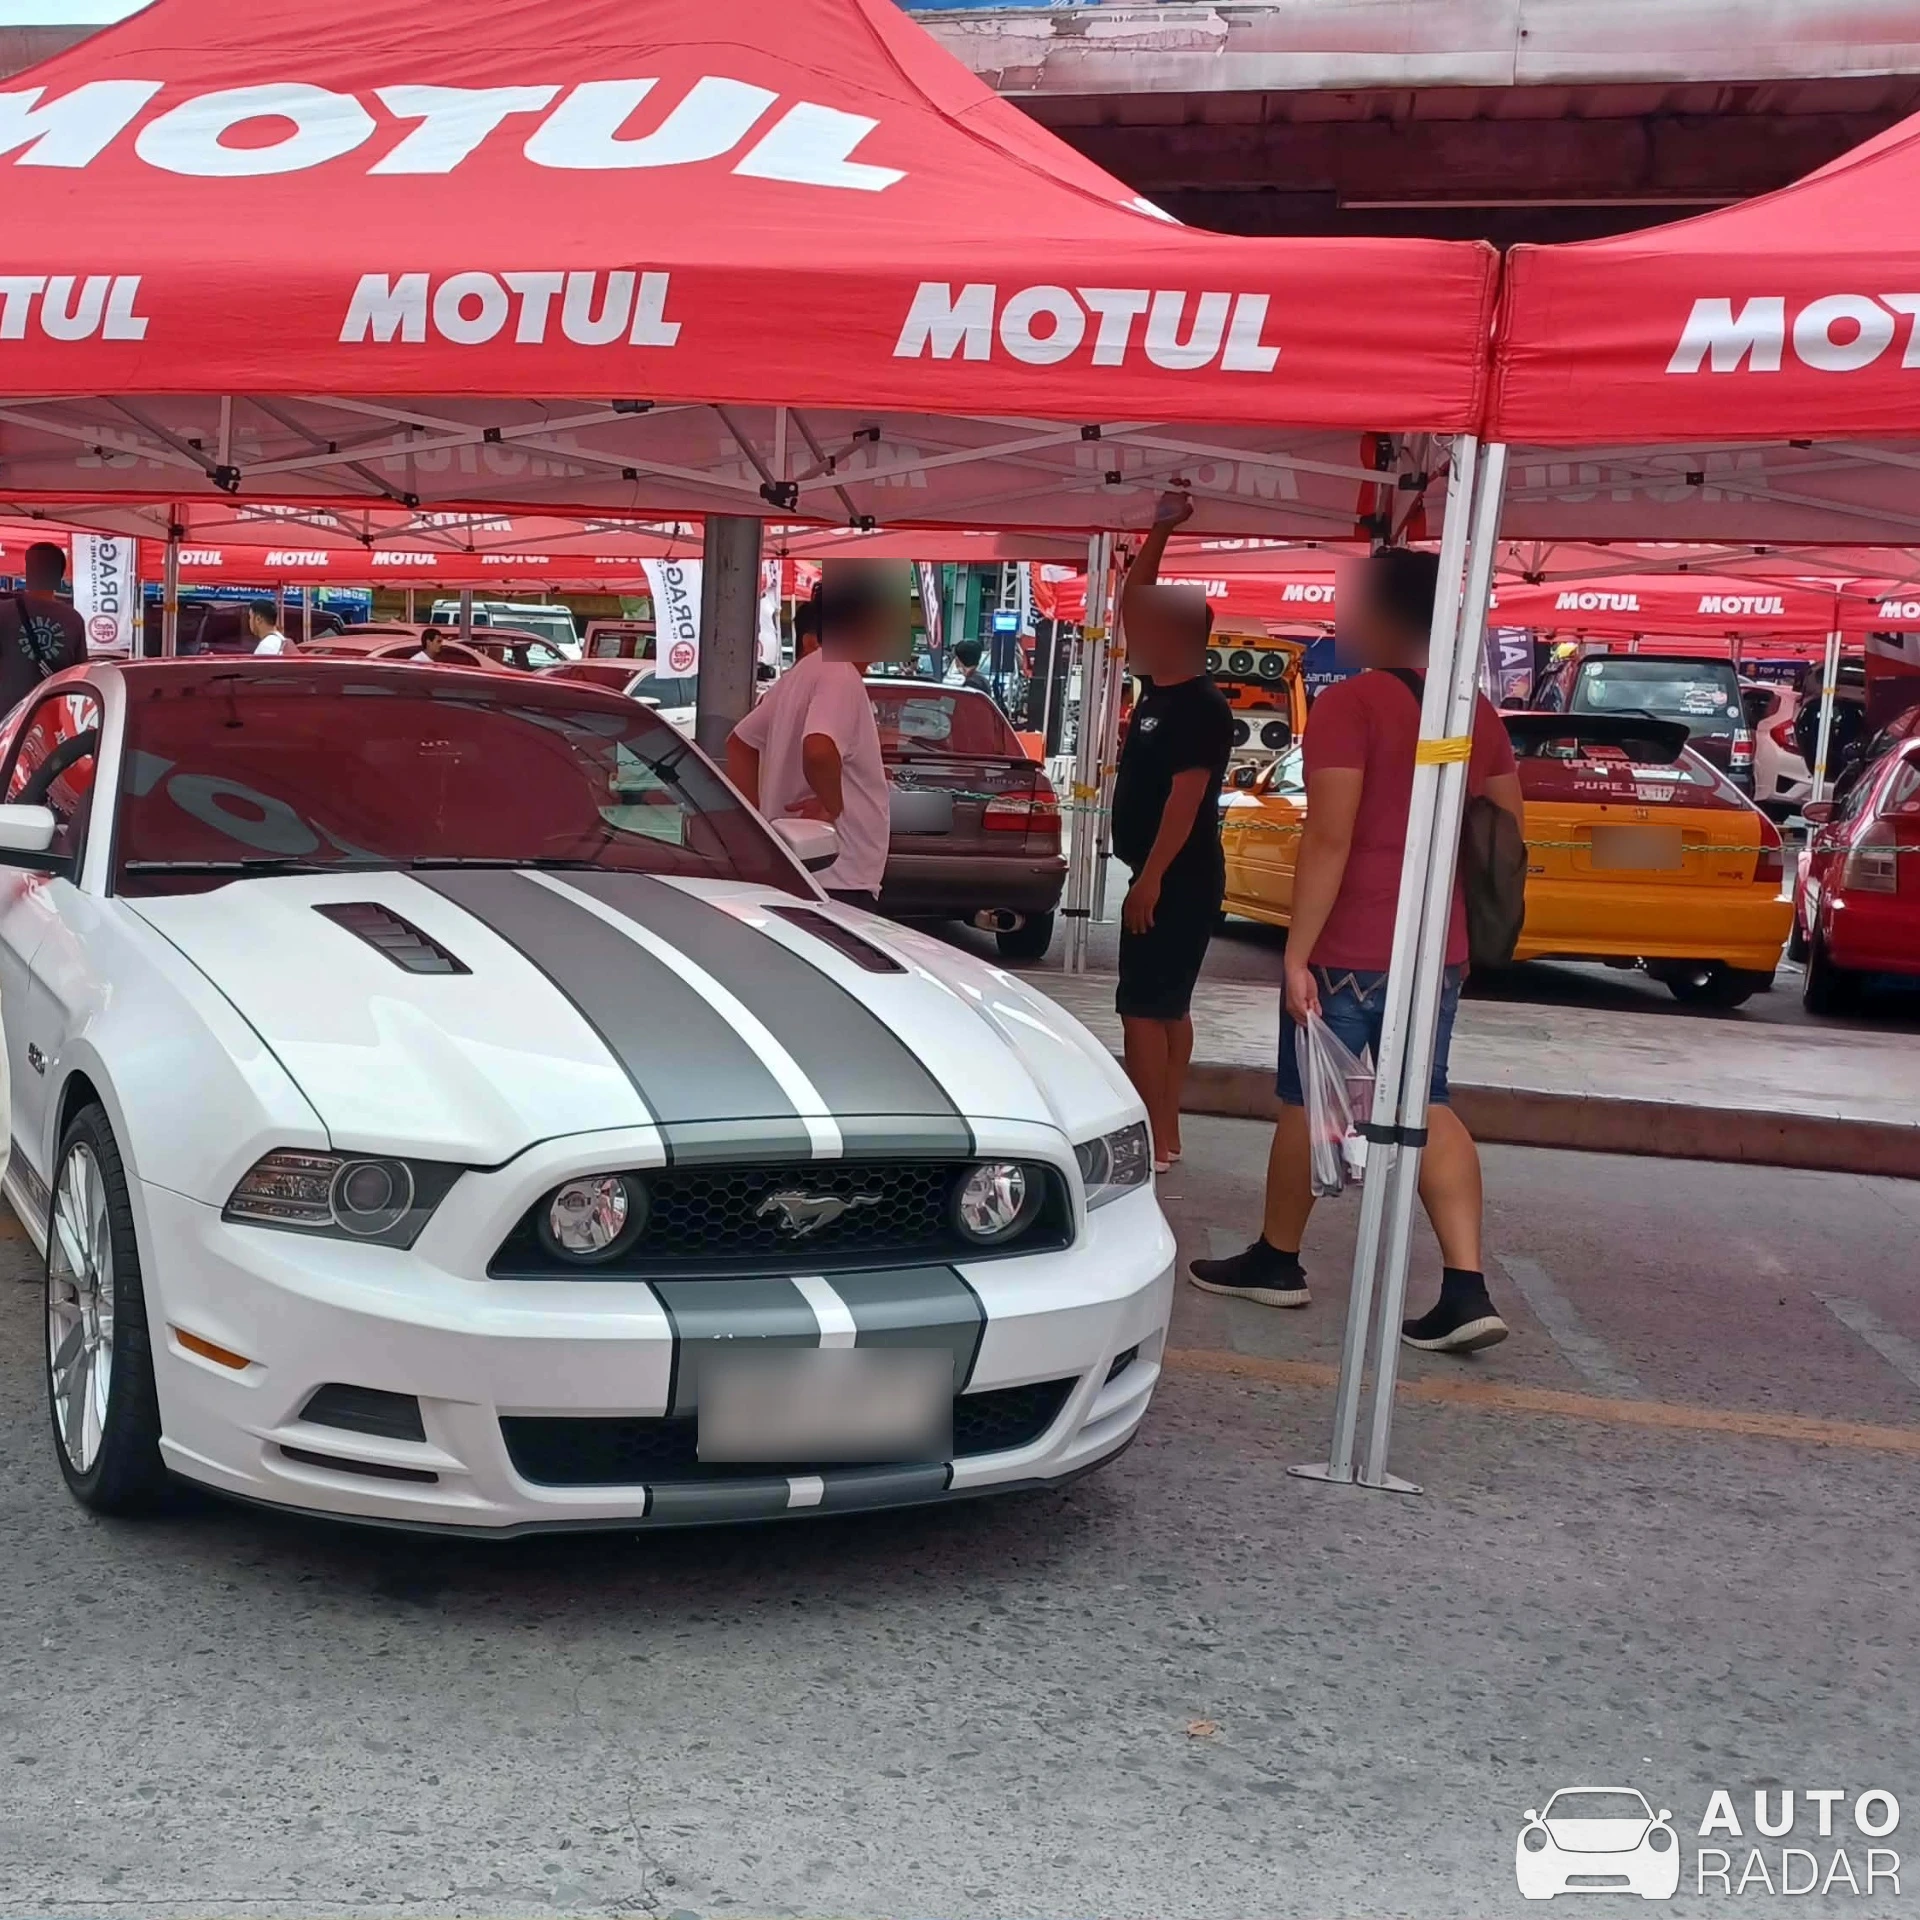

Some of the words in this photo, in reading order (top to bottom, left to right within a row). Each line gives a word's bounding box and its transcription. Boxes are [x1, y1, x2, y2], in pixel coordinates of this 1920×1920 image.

[0, 76, 908, 191] MOTUL
[338, 270, 682, 347] MOTUL
[892, 281, 1281, 372] MOTUL
[162, 550, 223, 566] OTUL
[264, 551, 329, 567] MOTUL
[371, 552, 437, 566] MOTUL
[1281, 584, 1336, 602] MOT
[1555, 592, 1640, 612] MOTUL
[1697, 595, 1785, 615] MOTUL
[1574, 781, 1623, 791] PURE
